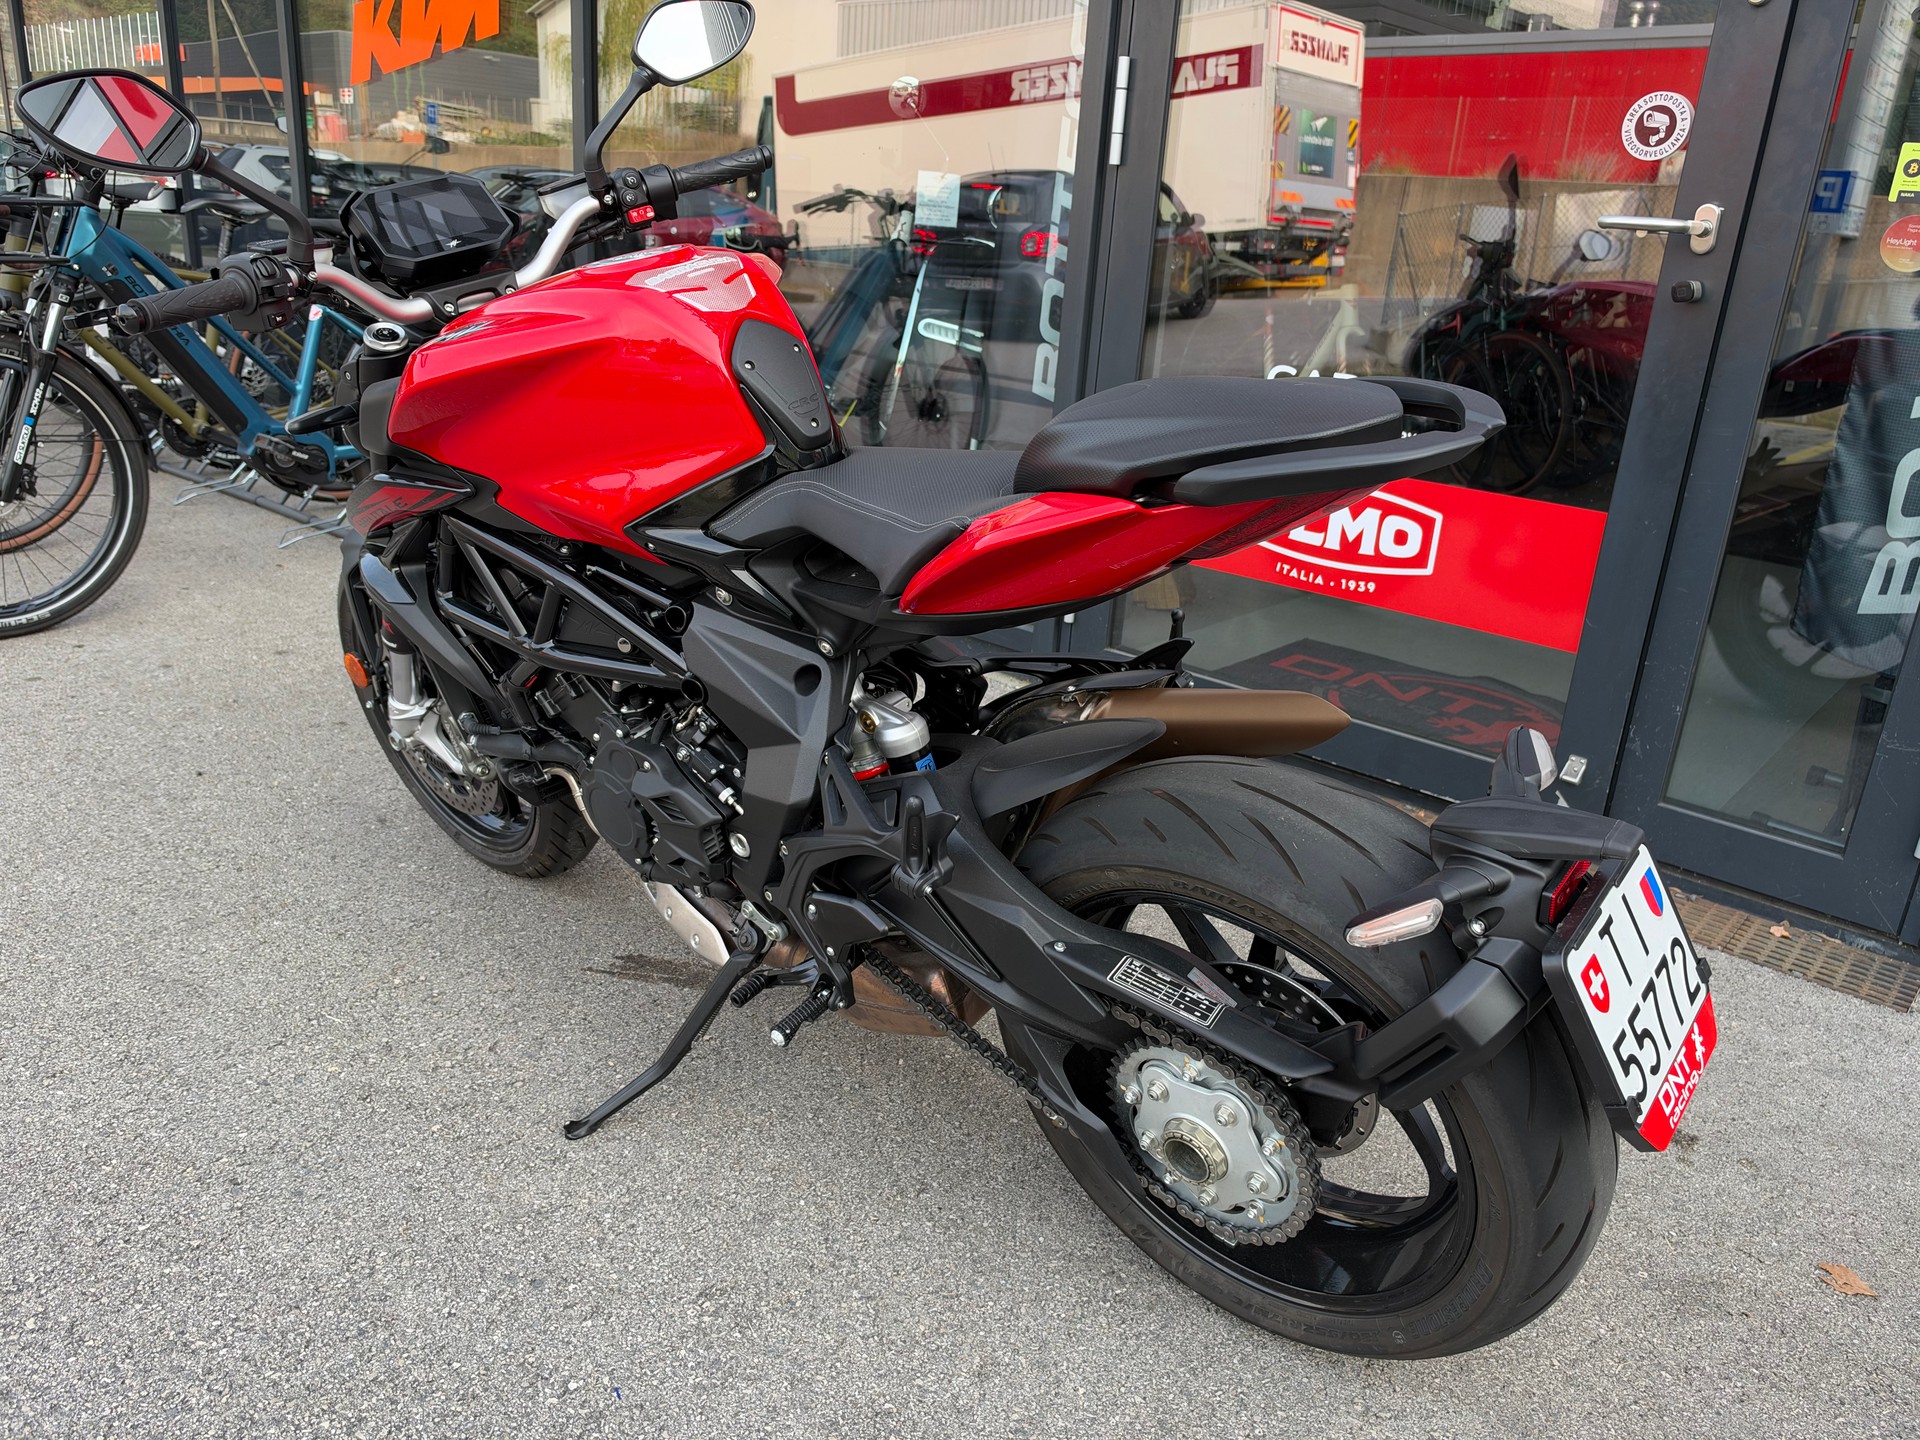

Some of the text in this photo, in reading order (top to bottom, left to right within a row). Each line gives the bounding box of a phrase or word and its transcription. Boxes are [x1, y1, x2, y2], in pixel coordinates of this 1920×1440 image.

[1626, 103, 1644, 124] AREA
[1643, 93, 1687, 117] SOTTOPOSTA
[1624, 127, 1687, 158] VIDEOSORVEGLIANZA
[1886, 236, 1917, 247] HeyLight
[1276, 561, 1376, 593] ITALIA 1939
[1599, 892, 1650, 987] TI
[1612, 936, 1702, 1103] 55772
[1657, 1045, 1691, 1117] DNT
[1669, 1069, 1700, 1130] racing
